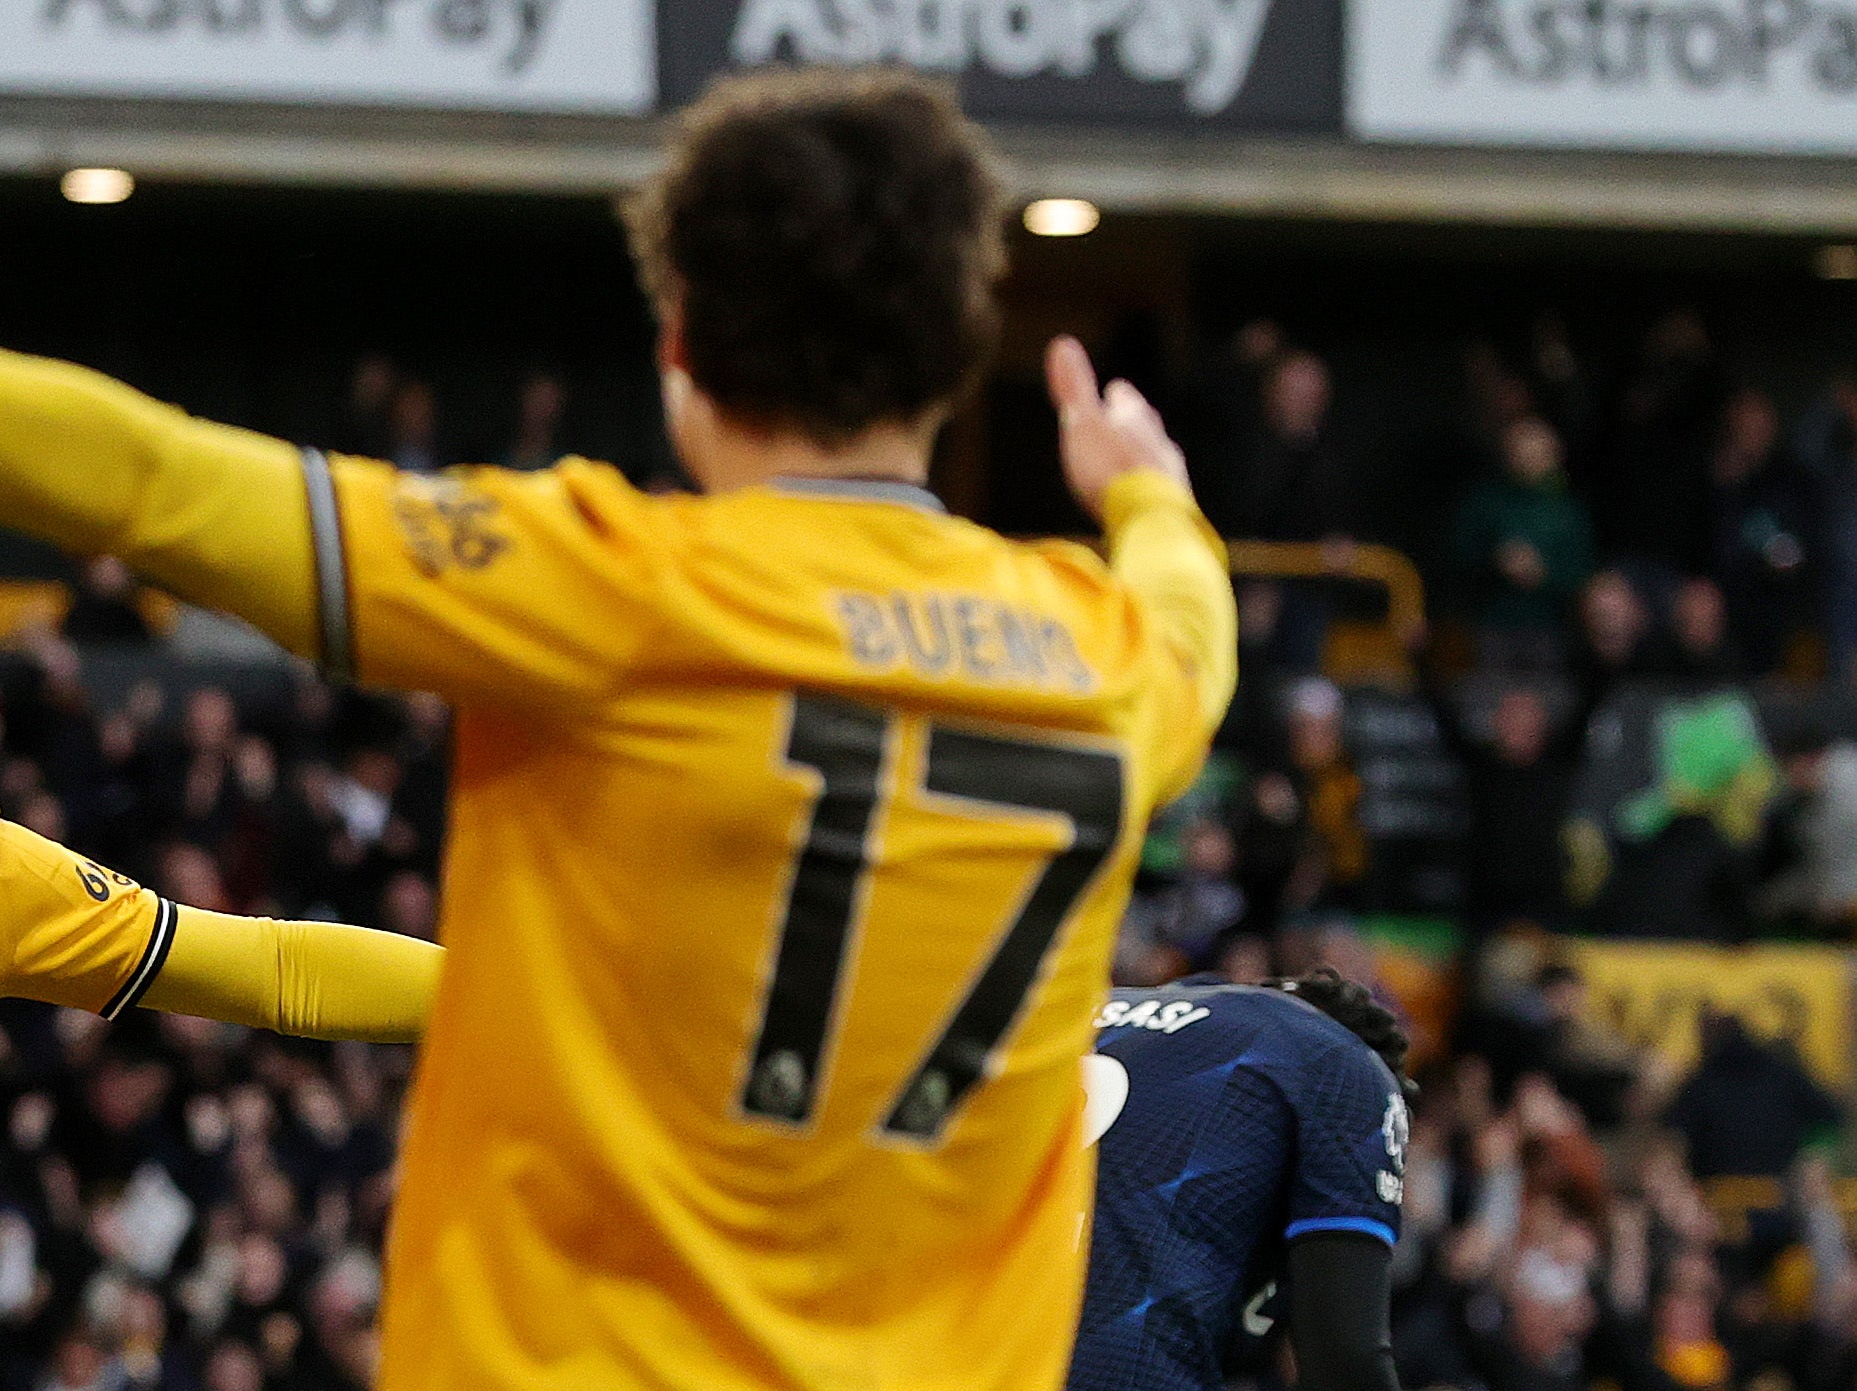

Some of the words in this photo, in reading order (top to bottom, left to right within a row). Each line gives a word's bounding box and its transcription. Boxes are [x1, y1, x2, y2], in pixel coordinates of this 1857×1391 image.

[1435, 0, 1857, 96] AstroPa
[733, 690, 1129, 1150] 17
[1092, 1000, 1211, 1034] SASI
